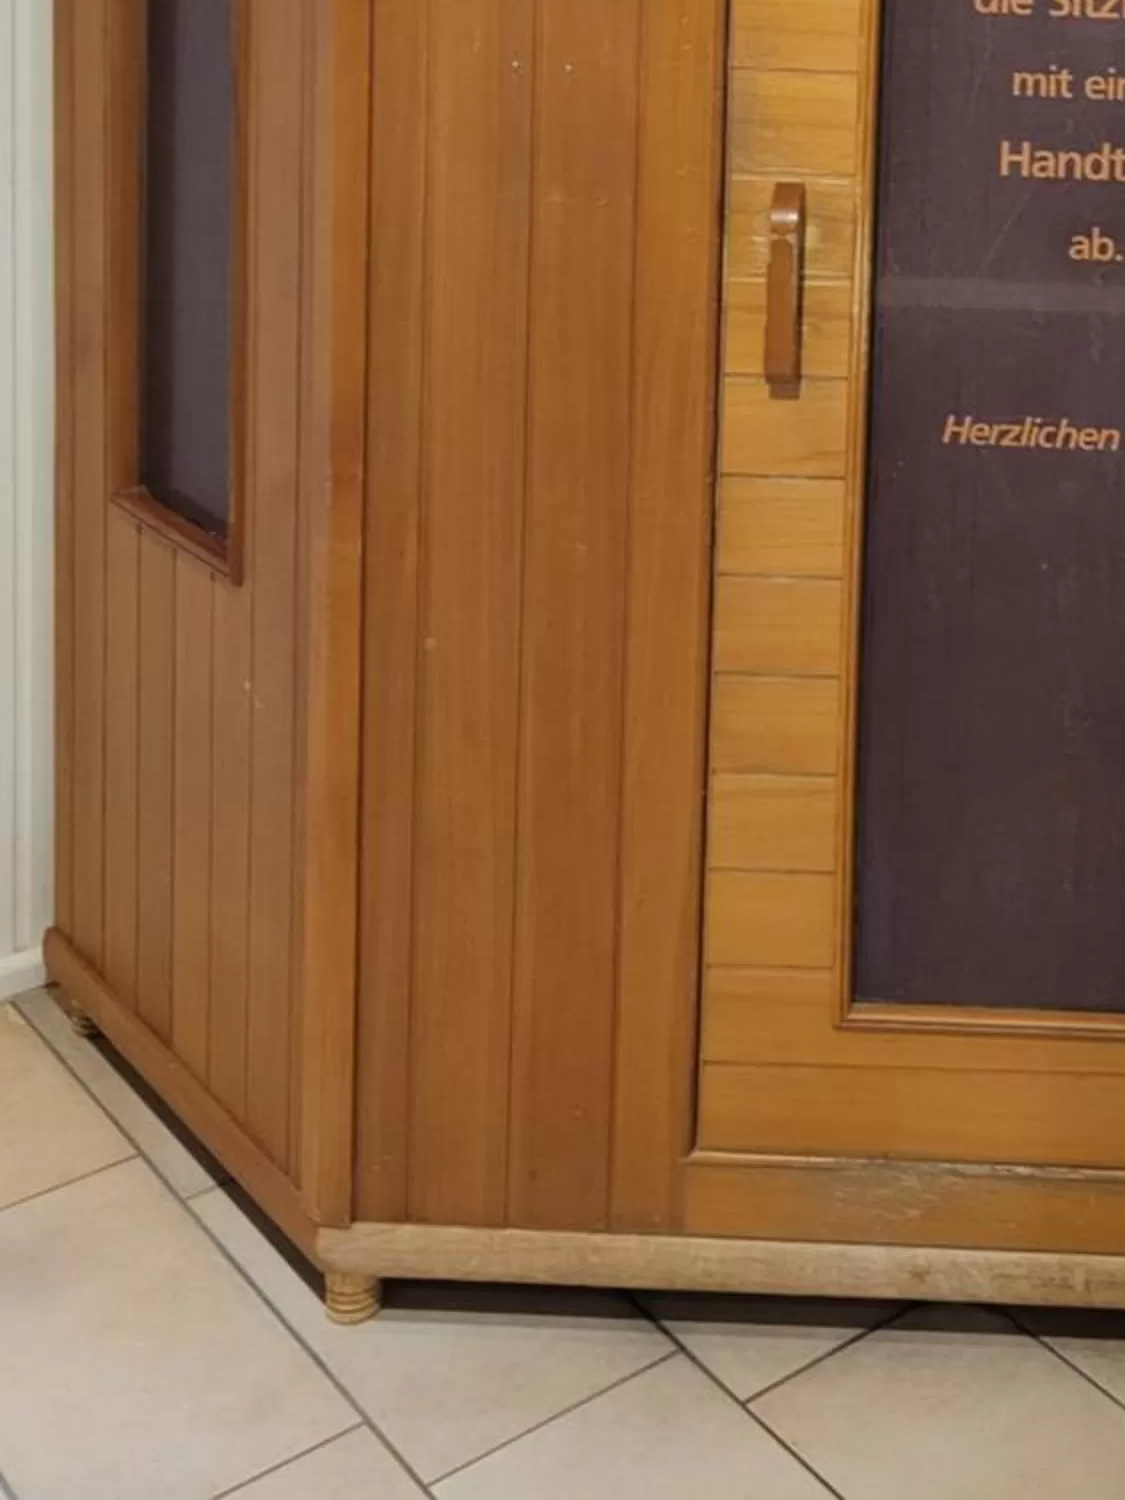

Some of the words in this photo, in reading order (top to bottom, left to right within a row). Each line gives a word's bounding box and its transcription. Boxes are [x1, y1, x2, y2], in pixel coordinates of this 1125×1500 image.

[1012, 64, 1073, 99] mit
[1069, 228, 1123, 262] ab.
[943, 416, 1120, 452] Herzlichen
